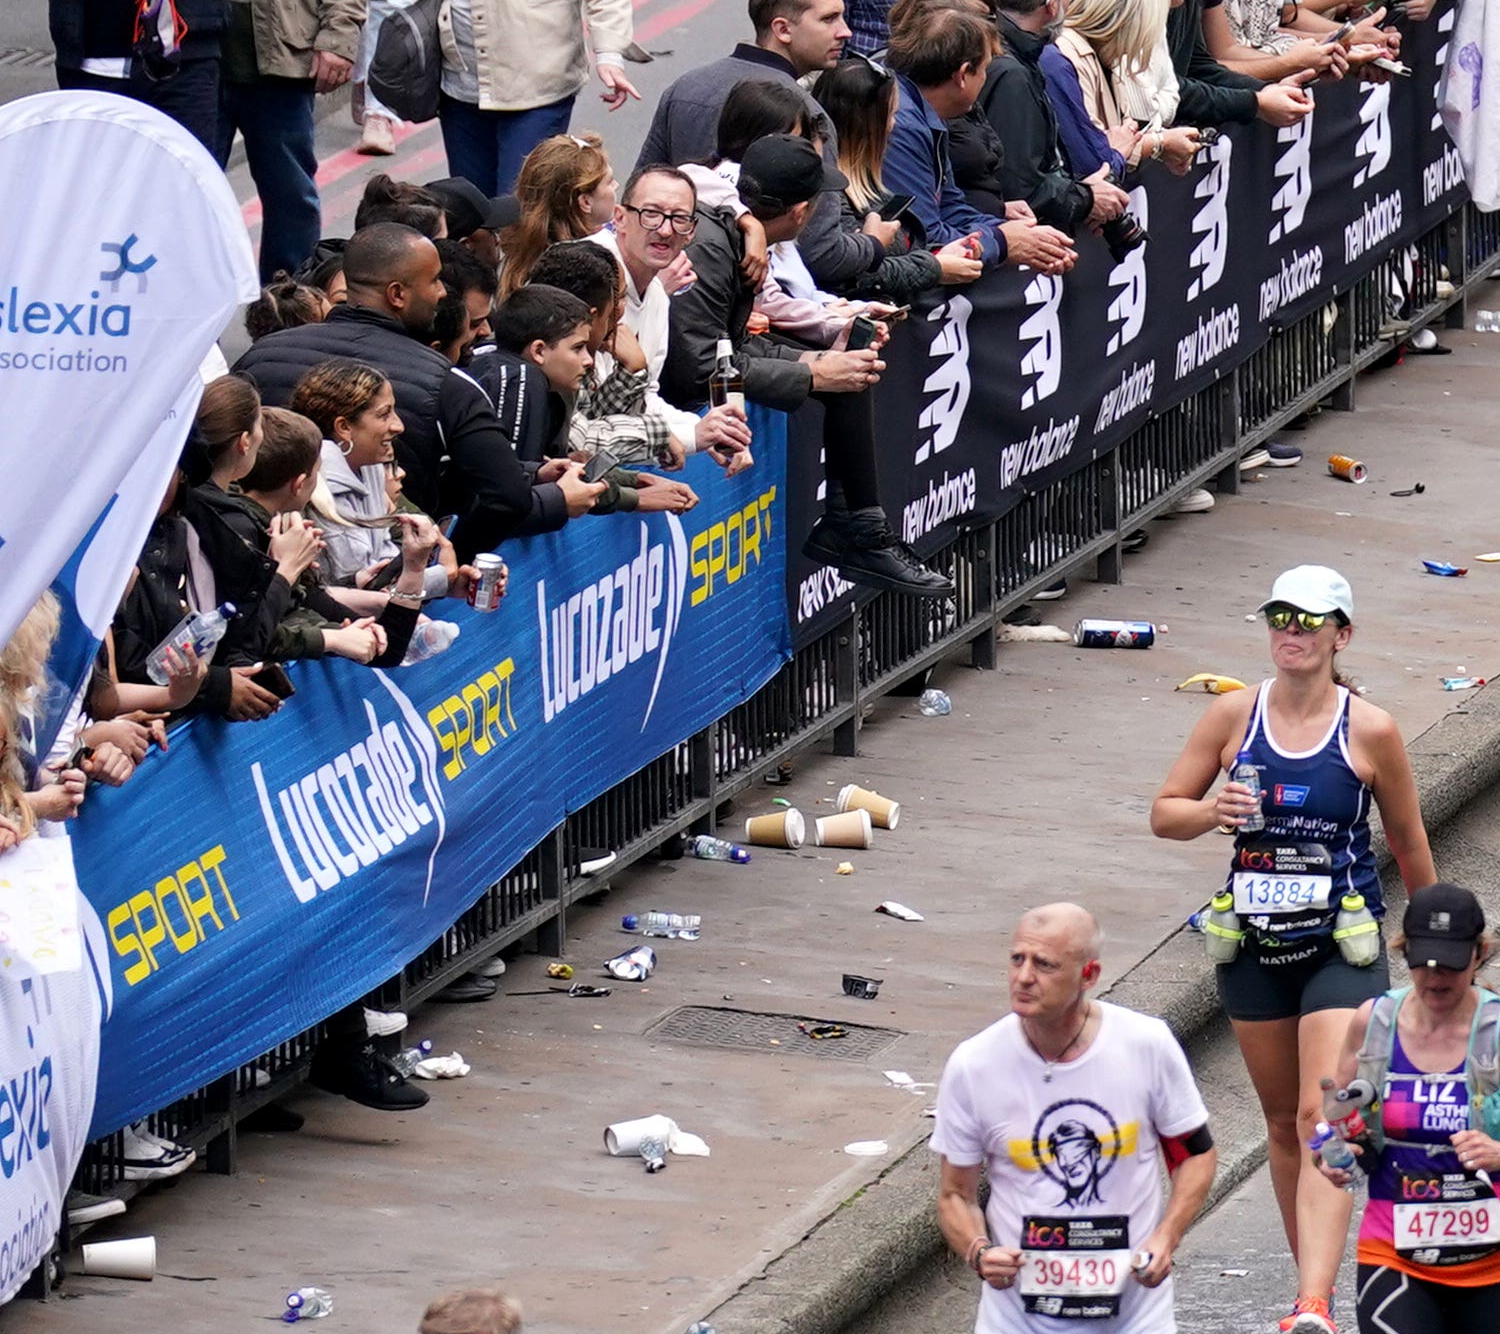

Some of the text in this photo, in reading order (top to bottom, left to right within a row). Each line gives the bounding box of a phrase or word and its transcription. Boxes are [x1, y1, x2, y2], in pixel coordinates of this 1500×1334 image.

[1258, 246, 1322, 321] new balance
[1174, 303, 1239, 380] new balance
[1094, 360, 1155, 434] new balance
[999, 414, 1079, 489] new balance
[902, 467, 976, 543] new balance
[690, 485, 777, 607] SPORT
[428, 658, 518, 782] SPORT
[1241, 849, 1273, 868] tcs
[1245, 879, 1316, 905] 13884
[108, 845, 239, 987] SPORT
[1259, 946, 1318, 965] NATHAN
[1413, 1080, 1456, 1103] LIZ
[1423, 1117, 1467, 1131] LUNG
[1408, 1208, 1490, 1237] 47299
[1034, 1259, 1116, 1286] 39430
